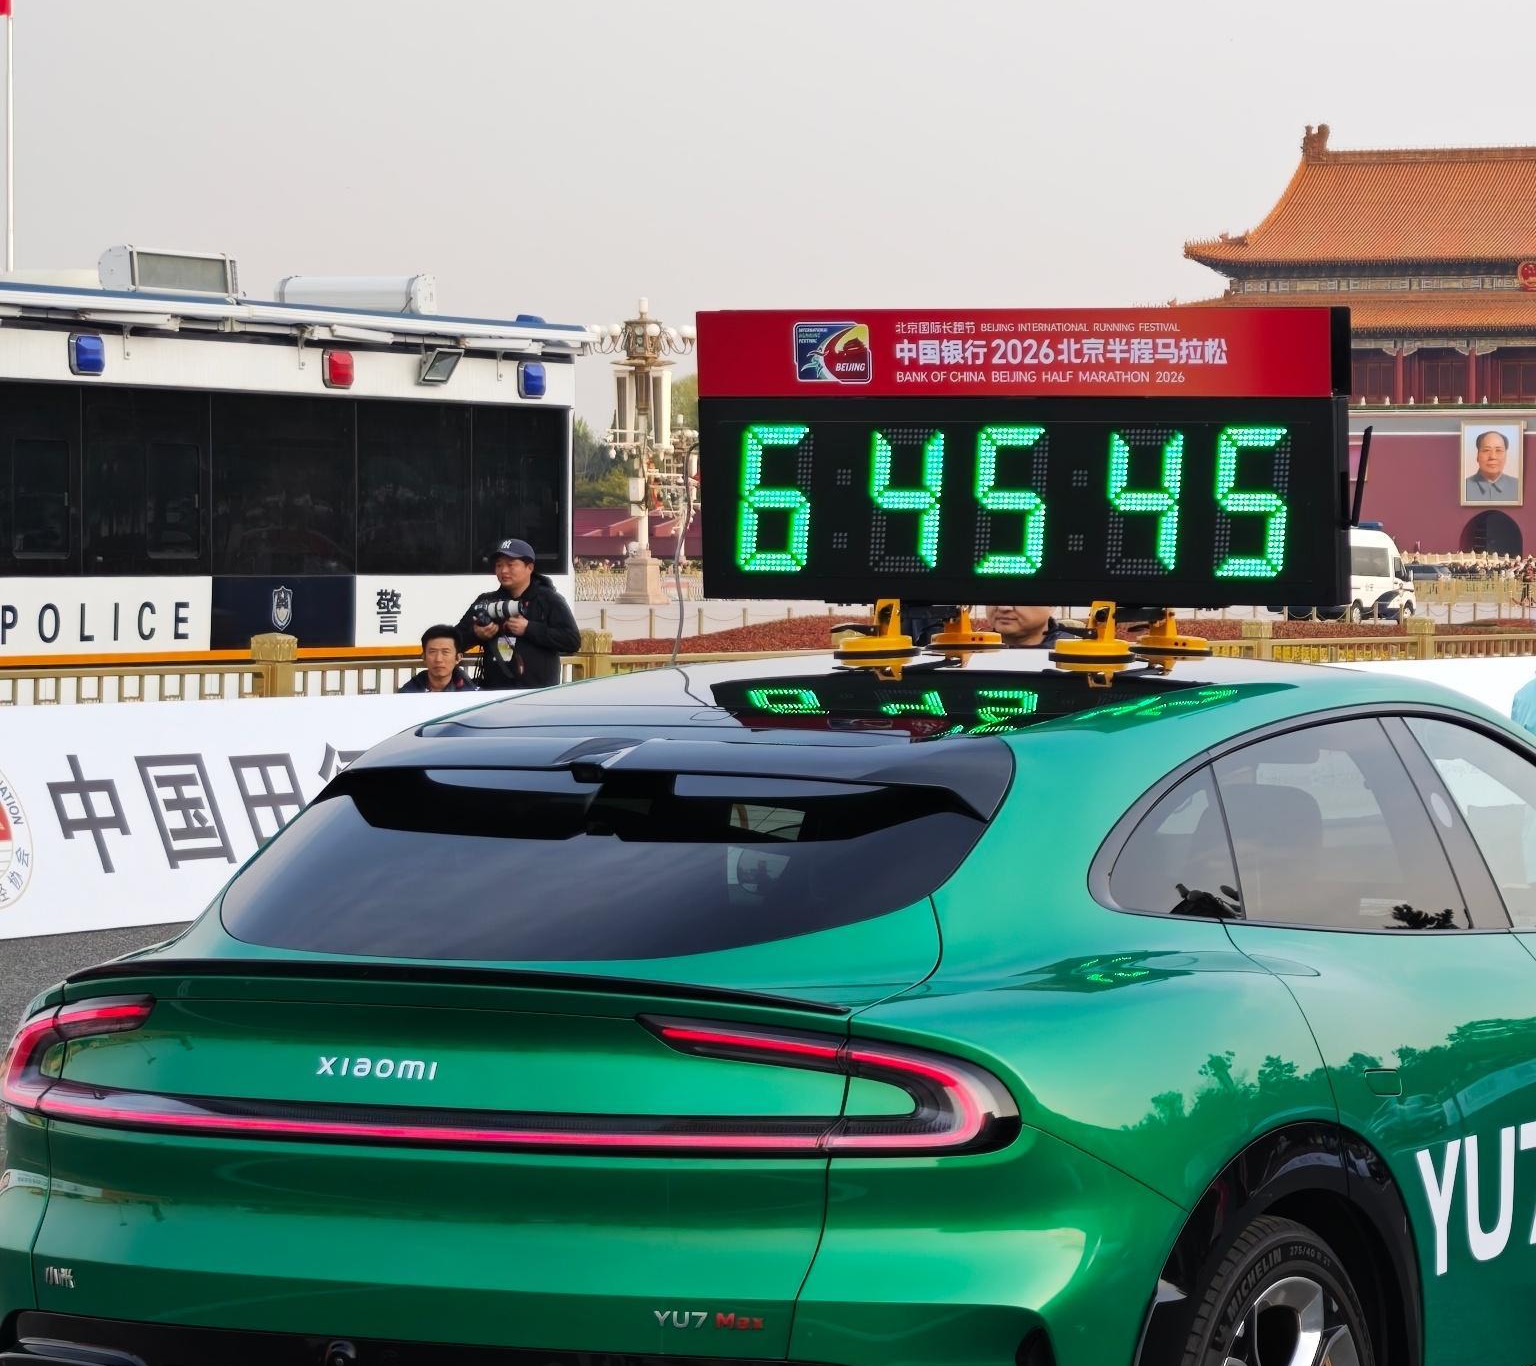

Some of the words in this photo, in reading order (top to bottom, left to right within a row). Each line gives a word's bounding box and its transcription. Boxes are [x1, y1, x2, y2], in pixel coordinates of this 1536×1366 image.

[895, 321, 976, 335] 北京国际长跑节
[980, 322, 1015, 333] BEIJING
[1018, 322, 1089, 333] INTERNATIONAL
[1093, 322, 1135, 332] RUNNING
[1138, 322, 1181, 332] FESTIVAL
[835, 362, 866, 372] BEIJING
[896, 370, 929, 383] BANK
[930, 370, 947, 383] OF
[949, 370, 986, 383] CHINA
[991, 370, 1037, 383] BEIJING
[1042, 370, 1074, 383] HALF
[1078, 370, 1150, 383] MARATHON
[1155, 370, 1186, 383] 2026
[376, 588, 402, 634] 警
[1, 601, 190, 645] POLICE
[1226, 1247, 1283, 1321] MICHELIN
[652, 1309, 709, 1330] YU7
[715, 1311, 765, 1331] Max
